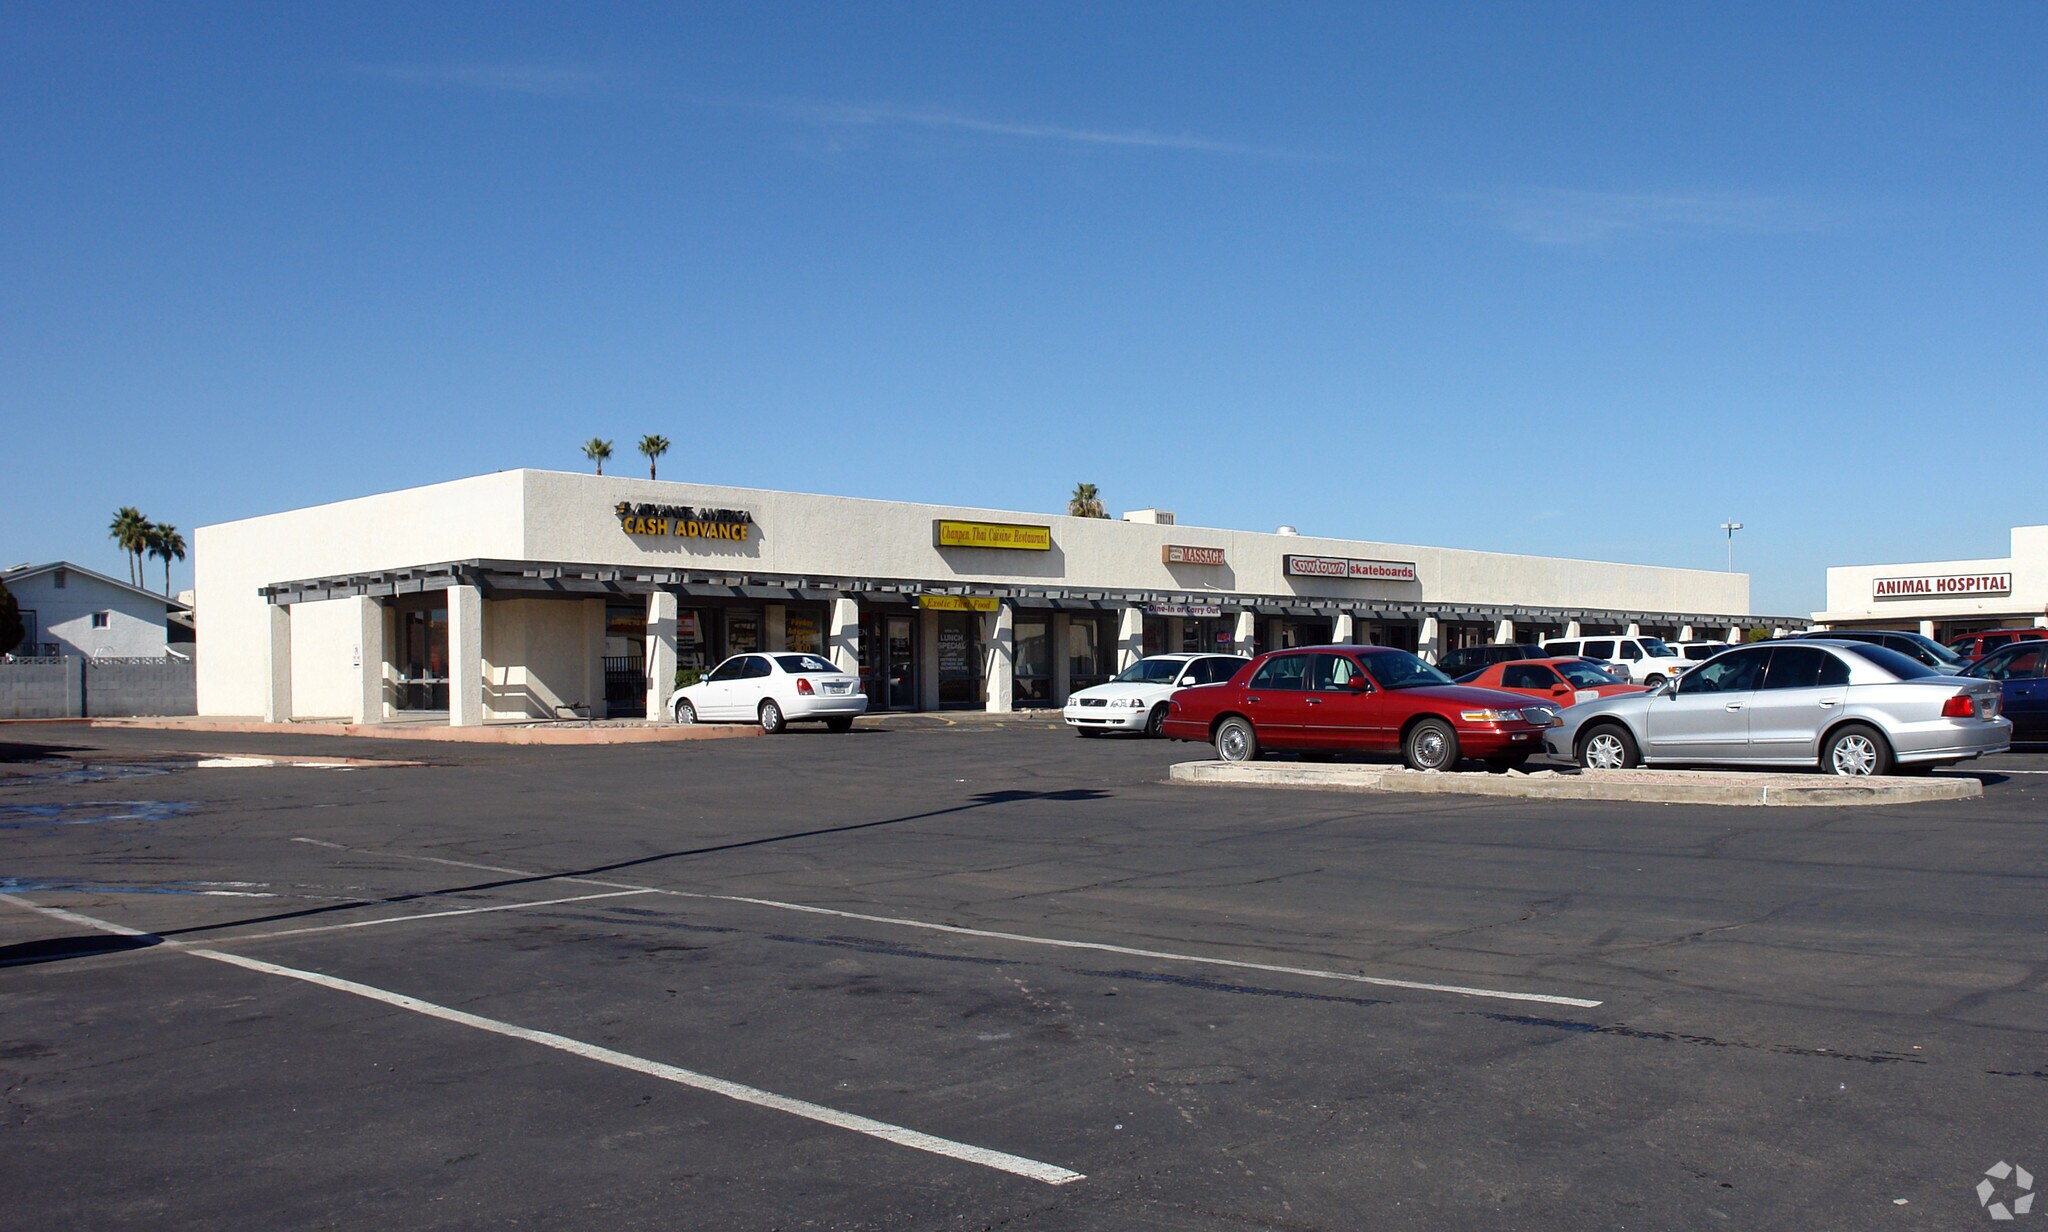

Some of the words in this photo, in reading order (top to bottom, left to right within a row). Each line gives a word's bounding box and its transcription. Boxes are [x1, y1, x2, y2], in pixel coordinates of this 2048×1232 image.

[623, 517, 668, 535] CASH
[674, 520, 747, 540] ADVANCE
[972, 527, 986, 541] Thai
[988, 528, 1011, 542] Cuisine
[1014, 530, 1047, 544] Restaurant
[1182, 547, 1223, 563] MASSAGE
[1350, 564, 1413, 577] skateboards
[1877, 579, 1931, 594] ANIMAL
[1936, 576, 2007, 592] HOSPITAL
[927, 598, 951, 608] Exotic
[972, 600, 992, 608] Food
[1148, 604, 1175, 613] Dine-In
[1186, 605, 1205, 615] Carry
[1206, 606, 1219, 614] Out
[940, 634, 963, 642] LUNCH
